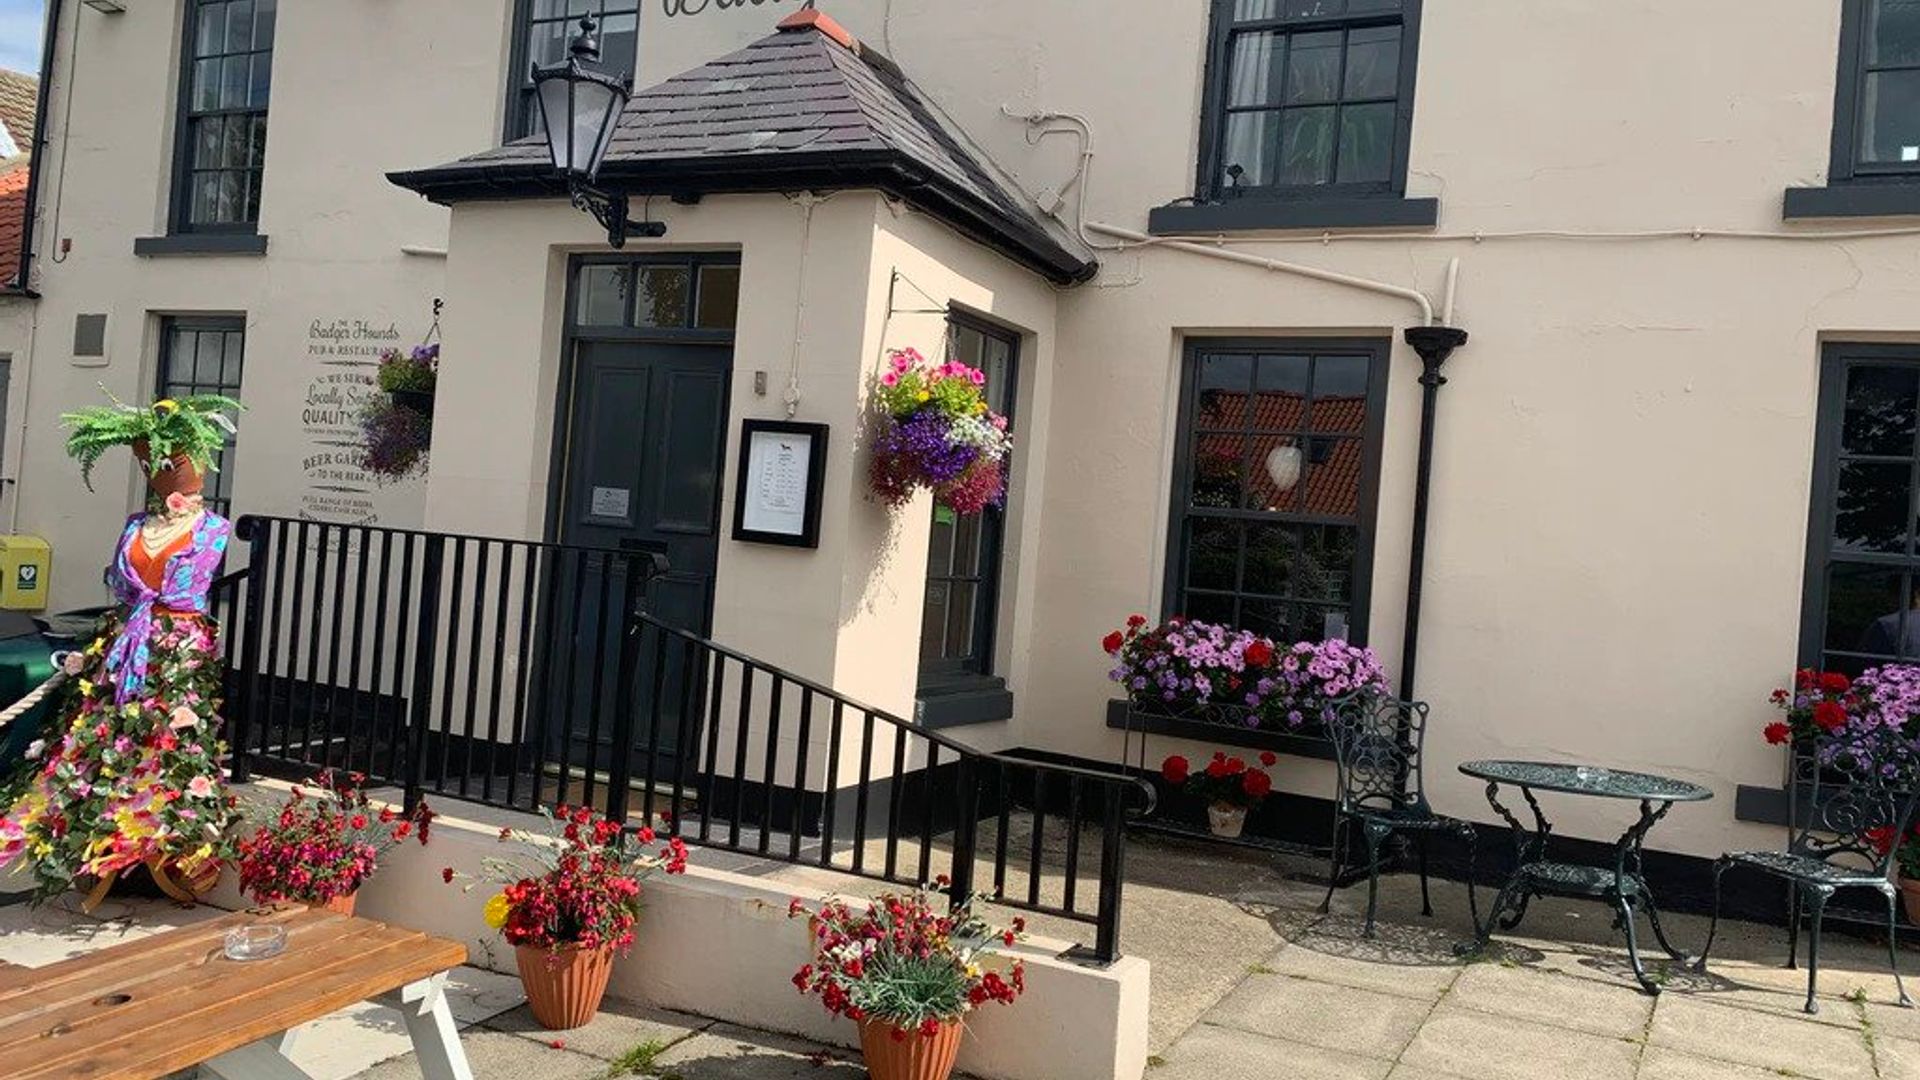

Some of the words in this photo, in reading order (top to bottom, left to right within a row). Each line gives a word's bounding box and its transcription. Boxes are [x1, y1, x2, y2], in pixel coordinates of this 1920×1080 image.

[352, 320, 400, 340] Hounds
[338, 345, 398, 357] RESTAUR
[304, 383, 344, 409] Locally
[302, 408, 356, 425] QUALITY
[302, 453, 332, 470] BEER
[318, 469, 328, 480] TO
[329, 470, 342, 481] THE
[345, 471, 366, 482] REAR
